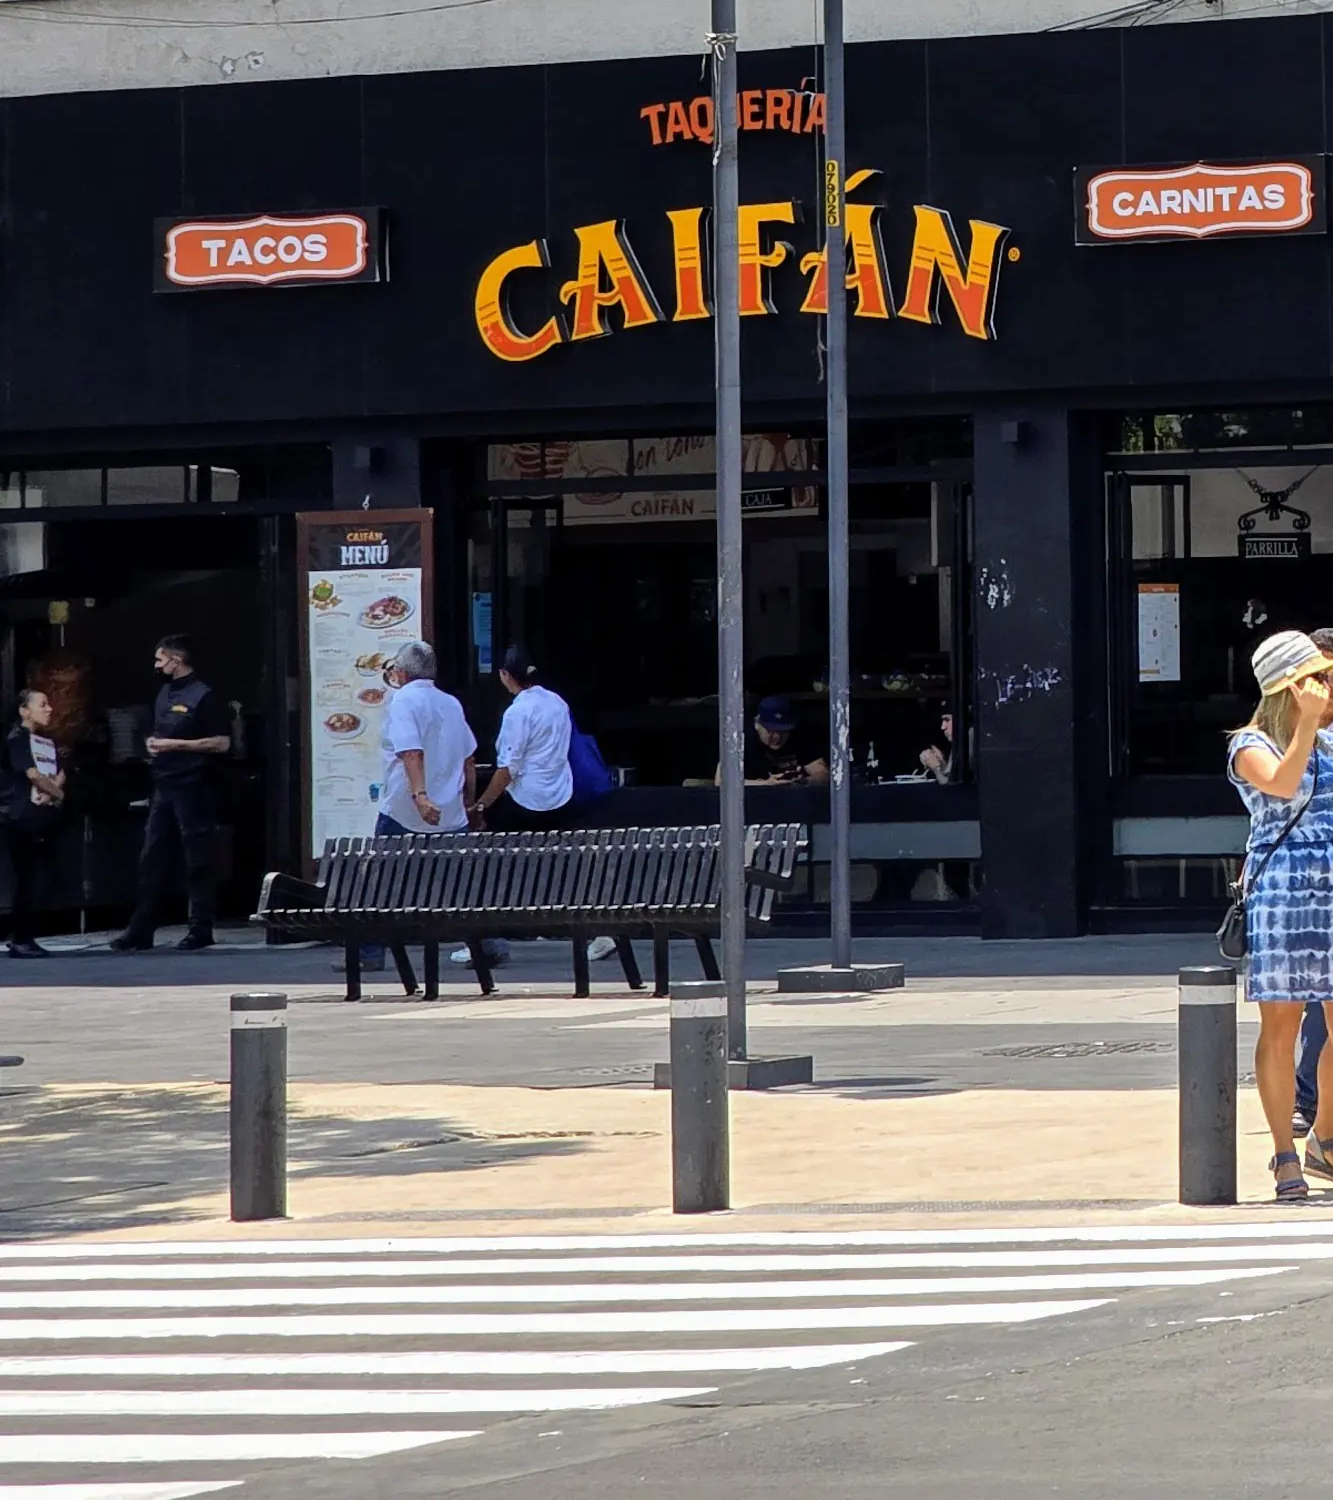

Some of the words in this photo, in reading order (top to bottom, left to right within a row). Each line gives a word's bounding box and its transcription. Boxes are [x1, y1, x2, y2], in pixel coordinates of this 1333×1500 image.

[640, 77, 829, 145] TAQERÍA
[1112, 184, 1286, 217] CARNITAS
[201, 233, 328, 268] TACOS
[475, 169, 1009, 362] CAIFÁN
[746, 493, 773, 507] CAJA
[340, 539, 390, 566] MENÚ
[1246, 541, 1299, 556] PARRILLA
